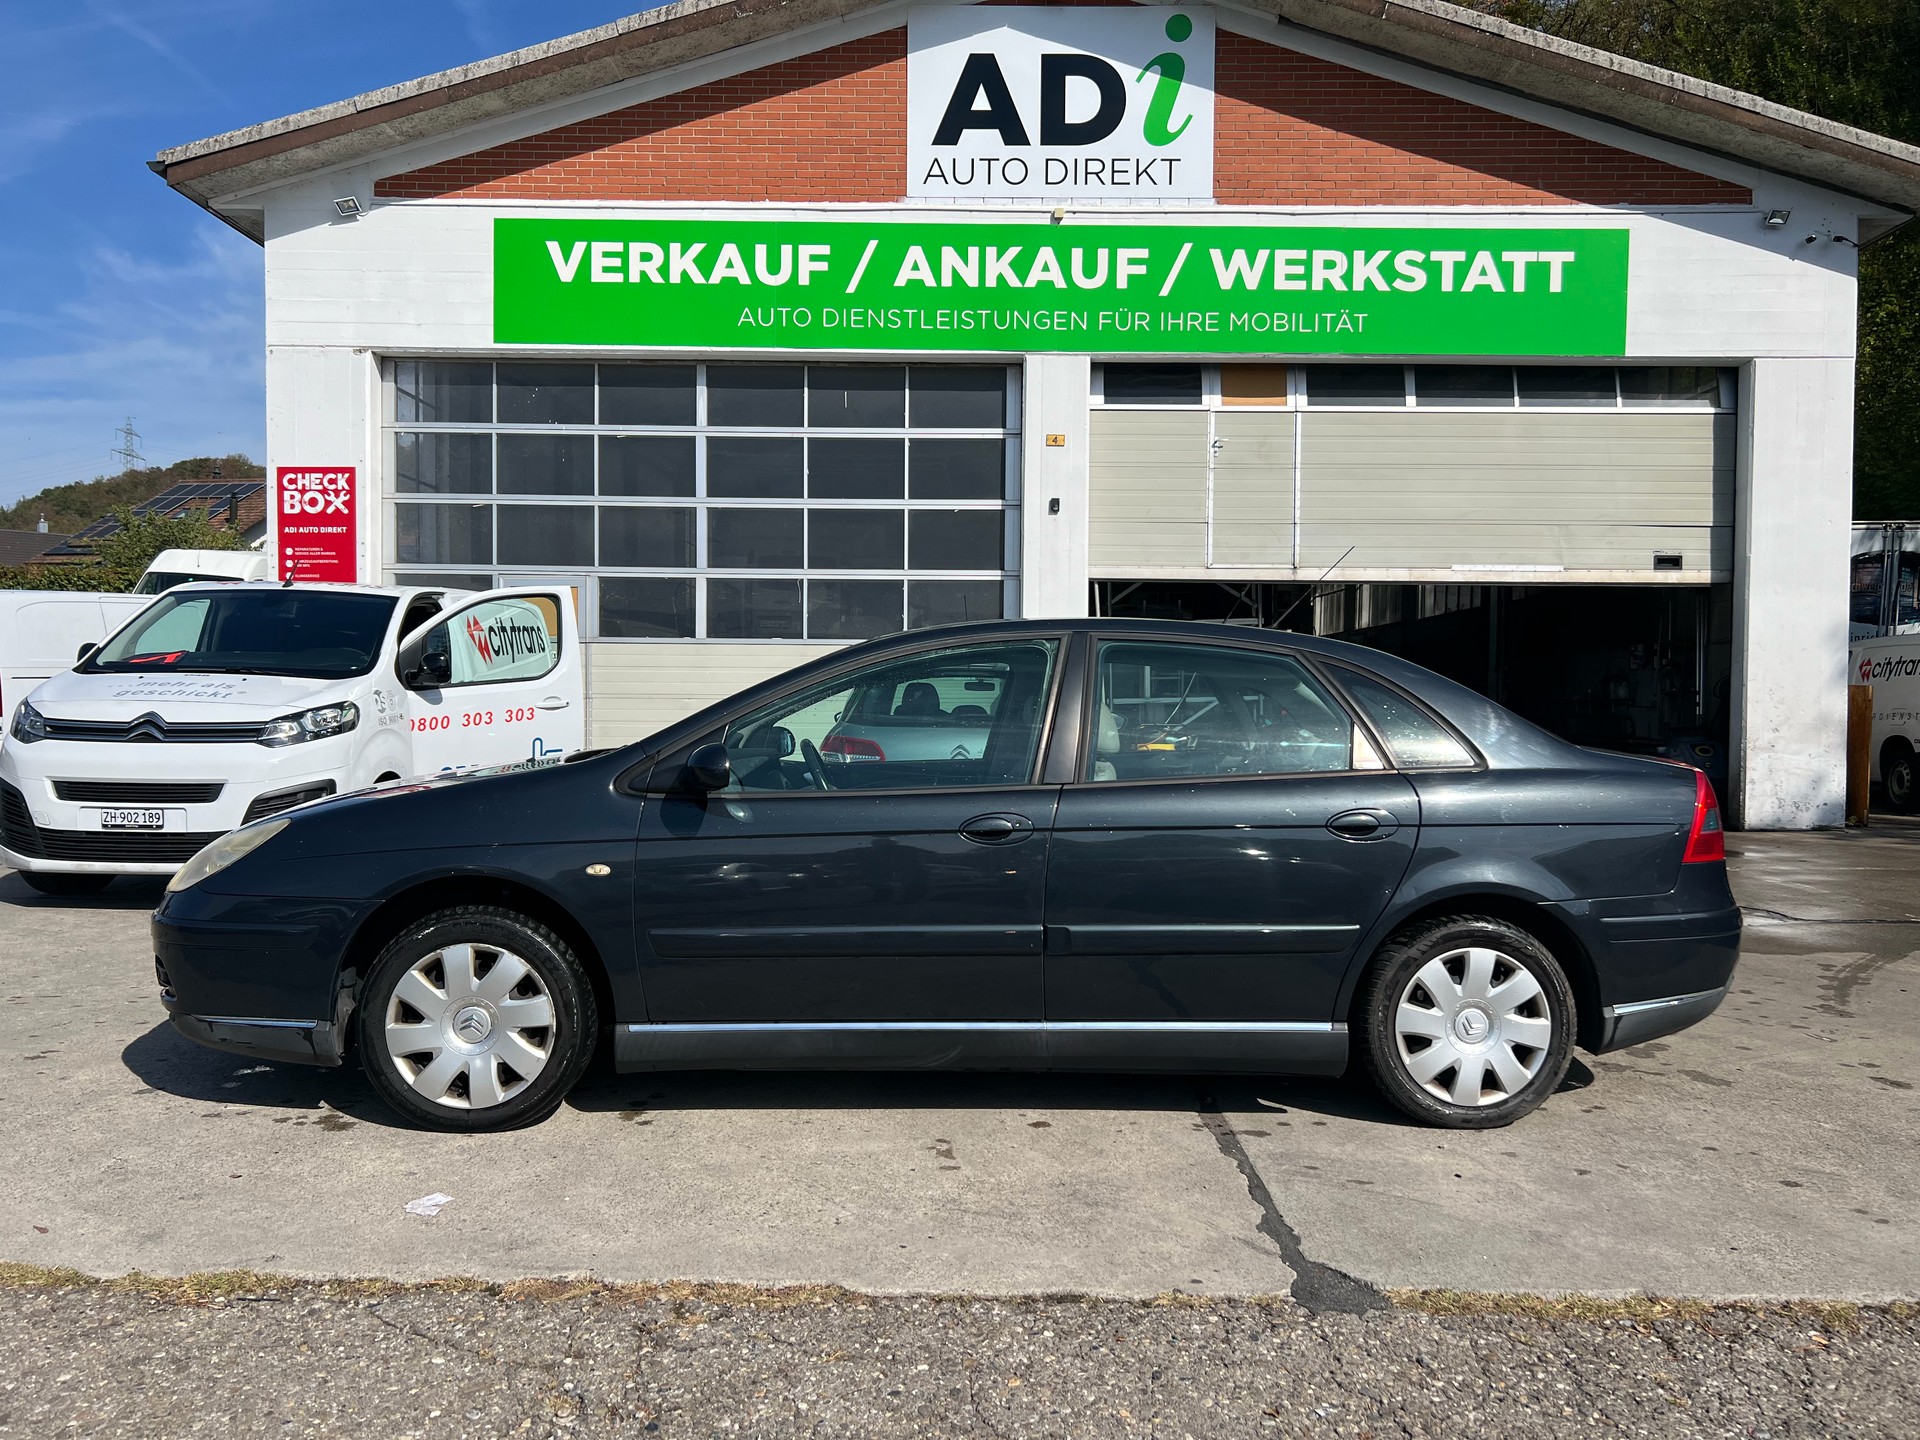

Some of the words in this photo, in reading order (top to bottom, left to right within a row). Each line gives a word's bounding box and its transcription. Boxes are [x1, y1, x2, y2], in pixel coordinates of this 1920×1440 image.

[923, 158, 1028, 185] AUTO
[1045, 158, 1181, 185] DIREKT
[546, 241, 830, 286] VERKAUF
[846, 240, 878, 293] /
[894, 246, 1148, 289] ANKAUF
[1159, 243, 1193, 296] /
[1210, 249, 1575, 292] WERKSTATT
[738, 307, 811, 328] AUTO
[823, 308, 1087, 331] DIENSTLEISTUNGEN
[1099, 307, 1149, 331] FÜR
[1161, 311, 1219, 332] IHRE
[1230, 309, 1368, 333] MOBILITÄT
[1052, 436, 1058, 444] 4
[283, 473, 350, 490] CHECK
[284, 490, 350, 514] BOX
[488, 616, 546, 663] citytrans
[462, 711, 493, 728] 303
[504, 707, 535, 723] 303
